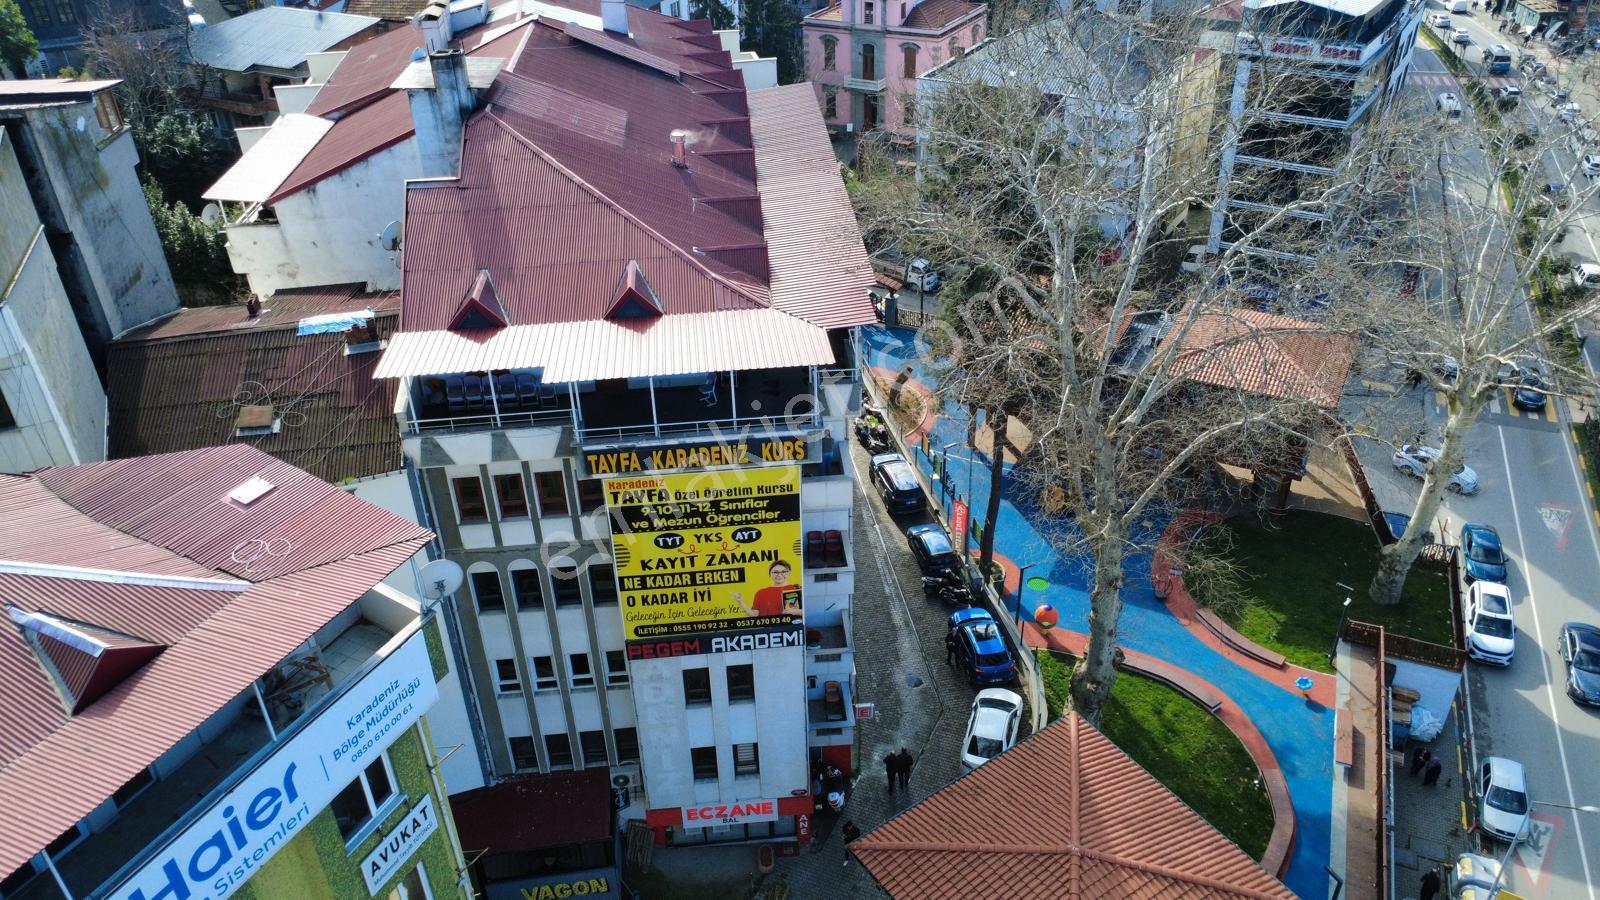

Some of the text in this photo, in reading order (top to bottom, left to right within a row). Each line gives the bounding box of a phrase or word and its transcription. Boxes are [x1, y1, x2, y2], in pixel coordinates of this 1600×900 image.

[587, 440, 806, 475] TAYFA KARADENİZ KURS
[608, 478, 665, 490] Karadeniz
[610, 482, 794, 505] TAYFA Özel Öğretim Kursu
[641, 498, 770, 517] 9-10-11-12. Sınıflar
[631, 510, 781, 529] ve Mezun Öğrenciler
[656, 530, 758, 547] TYT YKS AYT
[640, 549, 779, 572] KAYIT ZAMANI
[623, 569, 740, 590] NE KADAR ERKEN
[626, 587, 712, 608] O KADAR İYİ
[625, 609, 667, 624] Geleceğin
[667, 608, 685, 621] İçin
[687, 605, 727, 621] Geleceğin
[637, 625, 668, 635] İLETİŞİM
[673, 623, 691, 632] 0555
[693, 622, 707, 631] 190
[707, 621, 719, 630] 92
[719, 621, 728, 629] 32
[736, 620, 755, 628] 0537
[756, 618, 769, 626] 670
[770, 617, 782, 625] 93
[782, 616, 791, 624] 40
[627, 628, 805, 660] PEGEM AKADEMİ
[346, 679, 401, 731] Karadeniz
[331, 676, 421, 762] Bölge Müdürlüğü
[351, 703, 413, 763] 0850 610 00 61
[686, 801, 774, 821] ECZANE
[722, 816, 739, 824] BAL
[213, 801, 310, 897] Sistemleri
[371, 805, 428, 877] AVUKAT
[520, 877, 608, 900] VAGON
